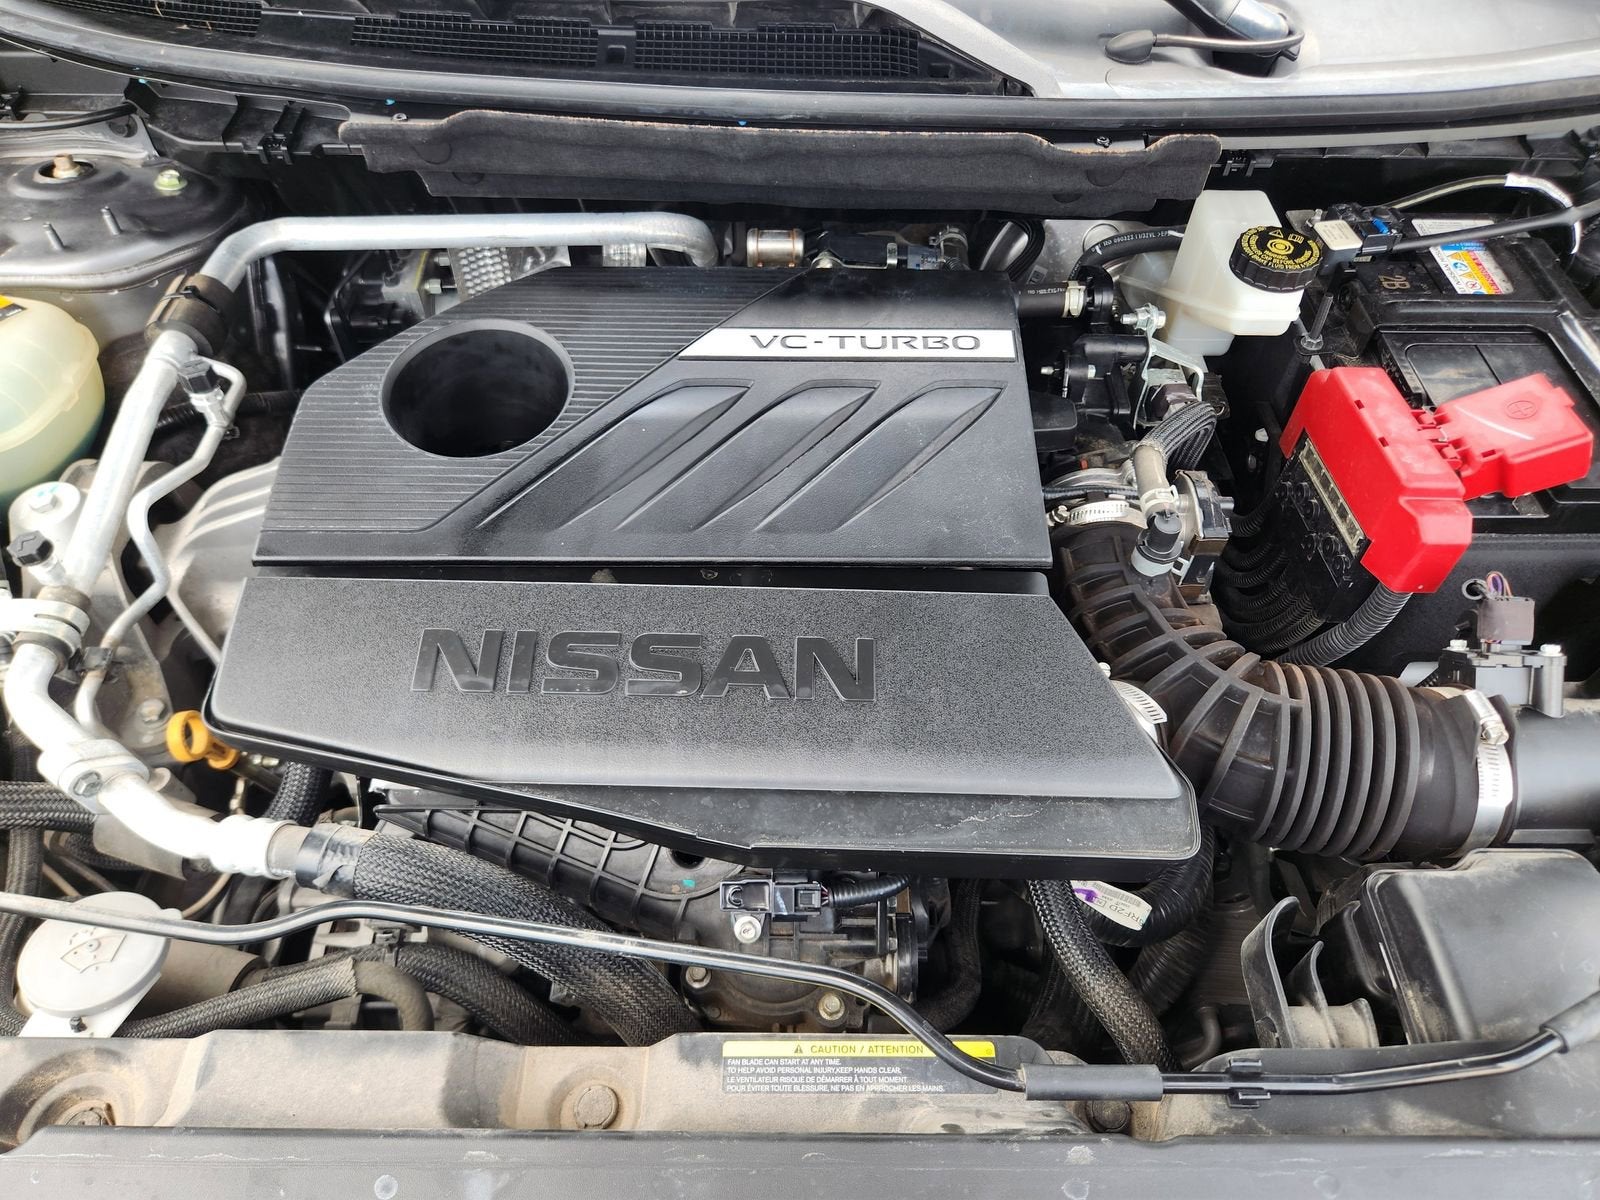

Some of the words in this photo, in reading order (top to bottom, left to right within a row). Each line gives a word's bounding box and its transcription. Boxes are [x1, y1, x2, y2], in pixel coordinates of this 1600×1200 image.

[749, 334, 981, 351] VC-TURBO
[410, 627, 877, 702] NISSAN
[810, 1045, 856, 1054] CAUTION
[868, 1045, 924, 1054] ATTENTION
[727, 1058, 740, 1066] FAN
[741, 1058, 763, 1066] BLADE
[764, 1058, 779, 1066] CAN
[780, 1058, 801, 1066] START
[801, 1058, 809, 1066] AT
[810, 1058, 824, 1066] ANY
[825, 1058, 842, 1066] TIME.
[727, 1066, 737, 1074] TO
[738, 1066, 755, 1074] HELP
[755, 1066, 776, 1074] AVOID
[777, 1066, 812, 1074] PERSONAL
[854, 1066, 877, 1074] HANDS
[878, 1066, 902, 1074] CLEAR.
[816, 1075, 853, 1083] DÉMARRER
[747, 1084, 770, 1092] ÉVITER
